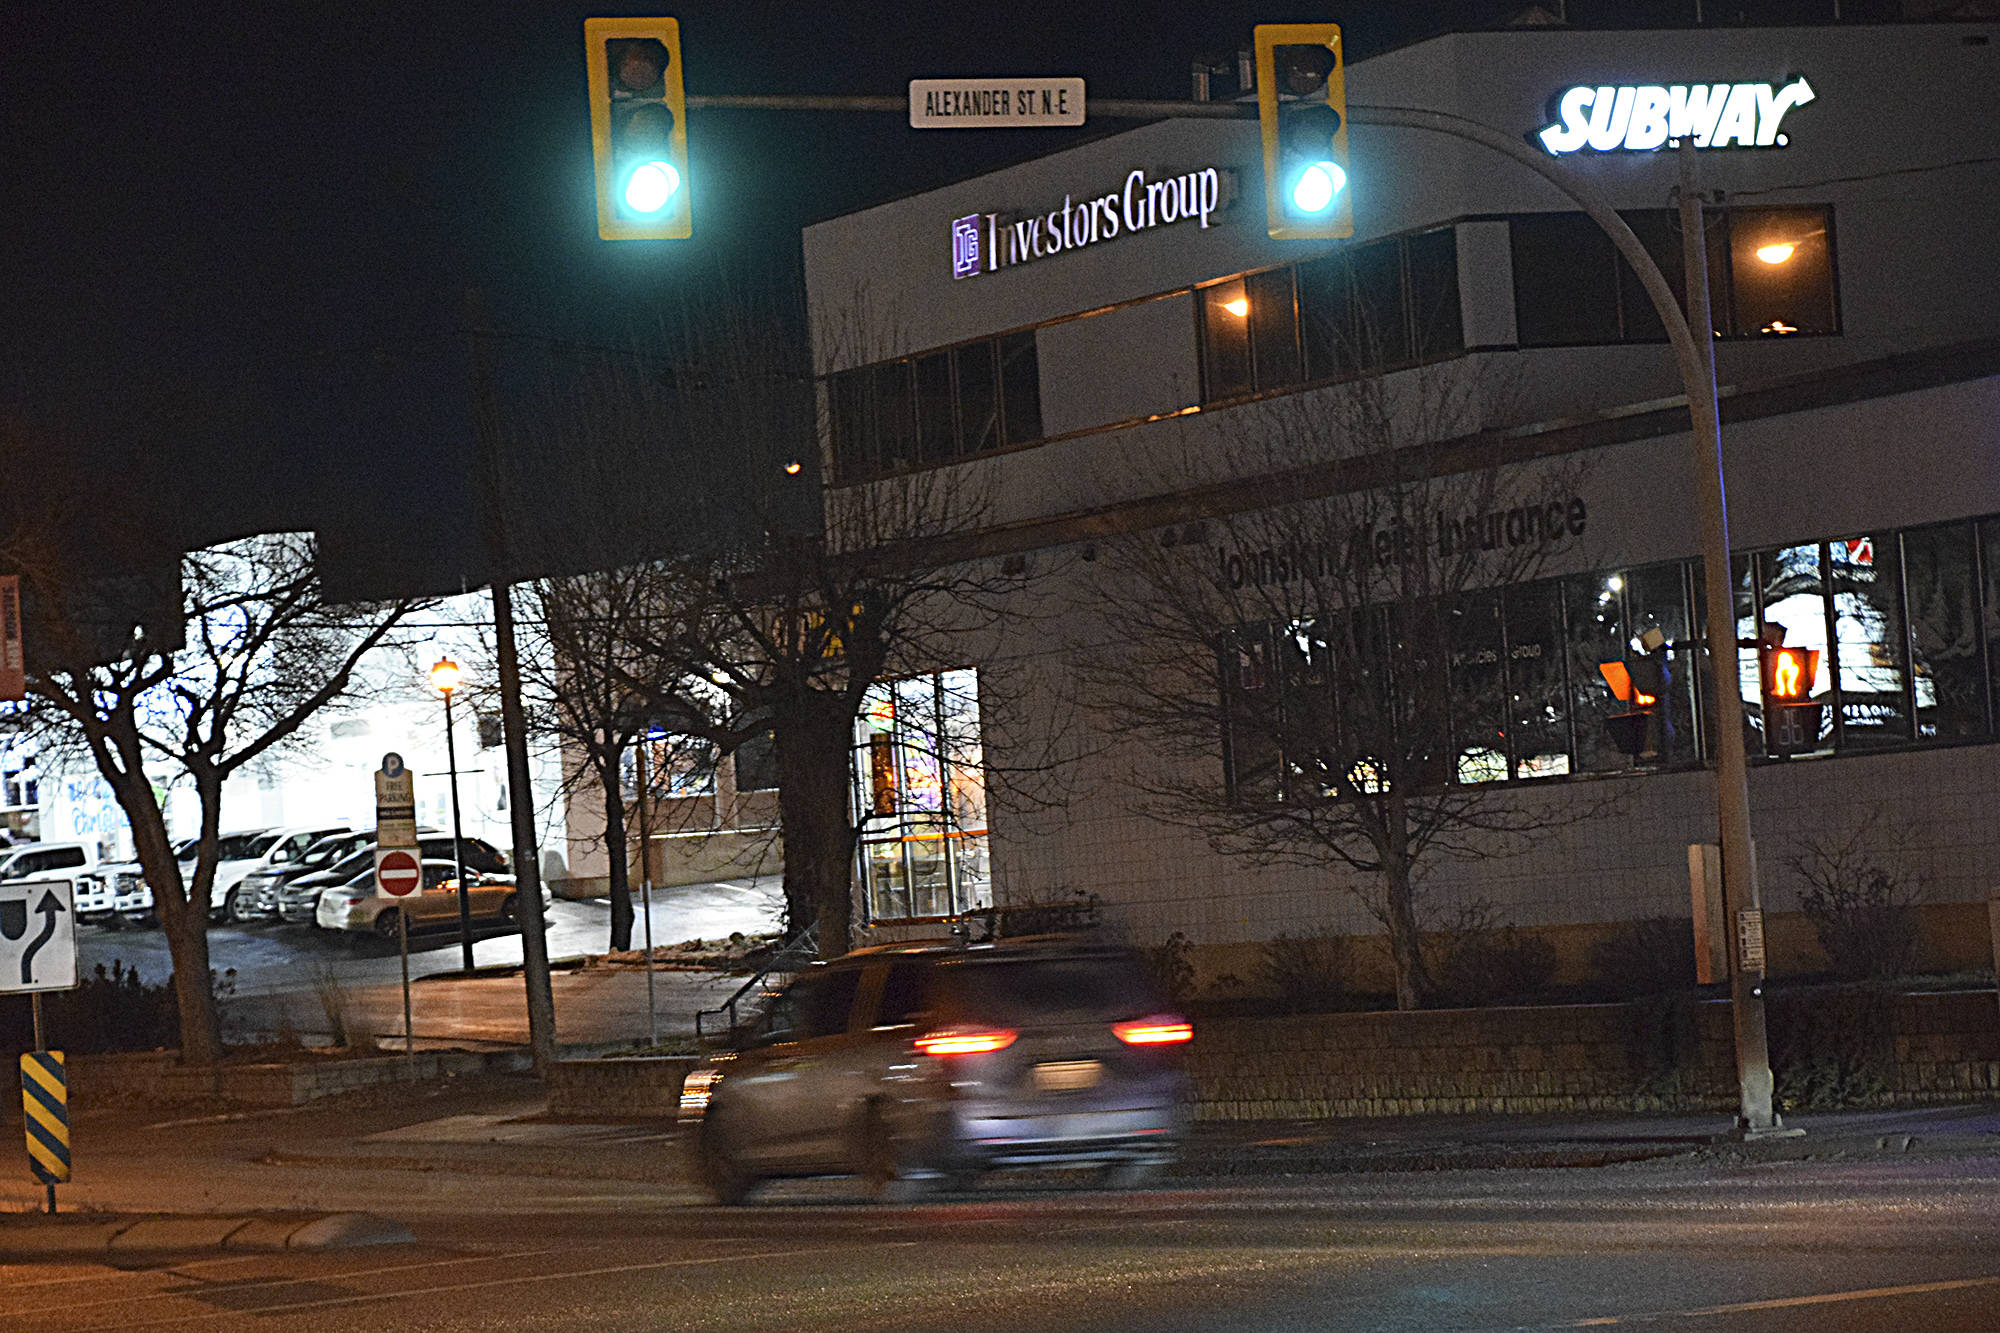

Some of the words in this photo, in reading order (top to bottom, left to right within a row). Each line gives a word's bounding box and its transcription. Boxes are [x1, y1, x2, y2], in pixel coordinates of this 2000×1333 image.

[925, 90, 1011, 117] ALEXANDER
[1540, 76, 1815, 157] SUBWAY
[985, 193, 1119, 272] Investors
[1123, 167, 1219, 232] Group
